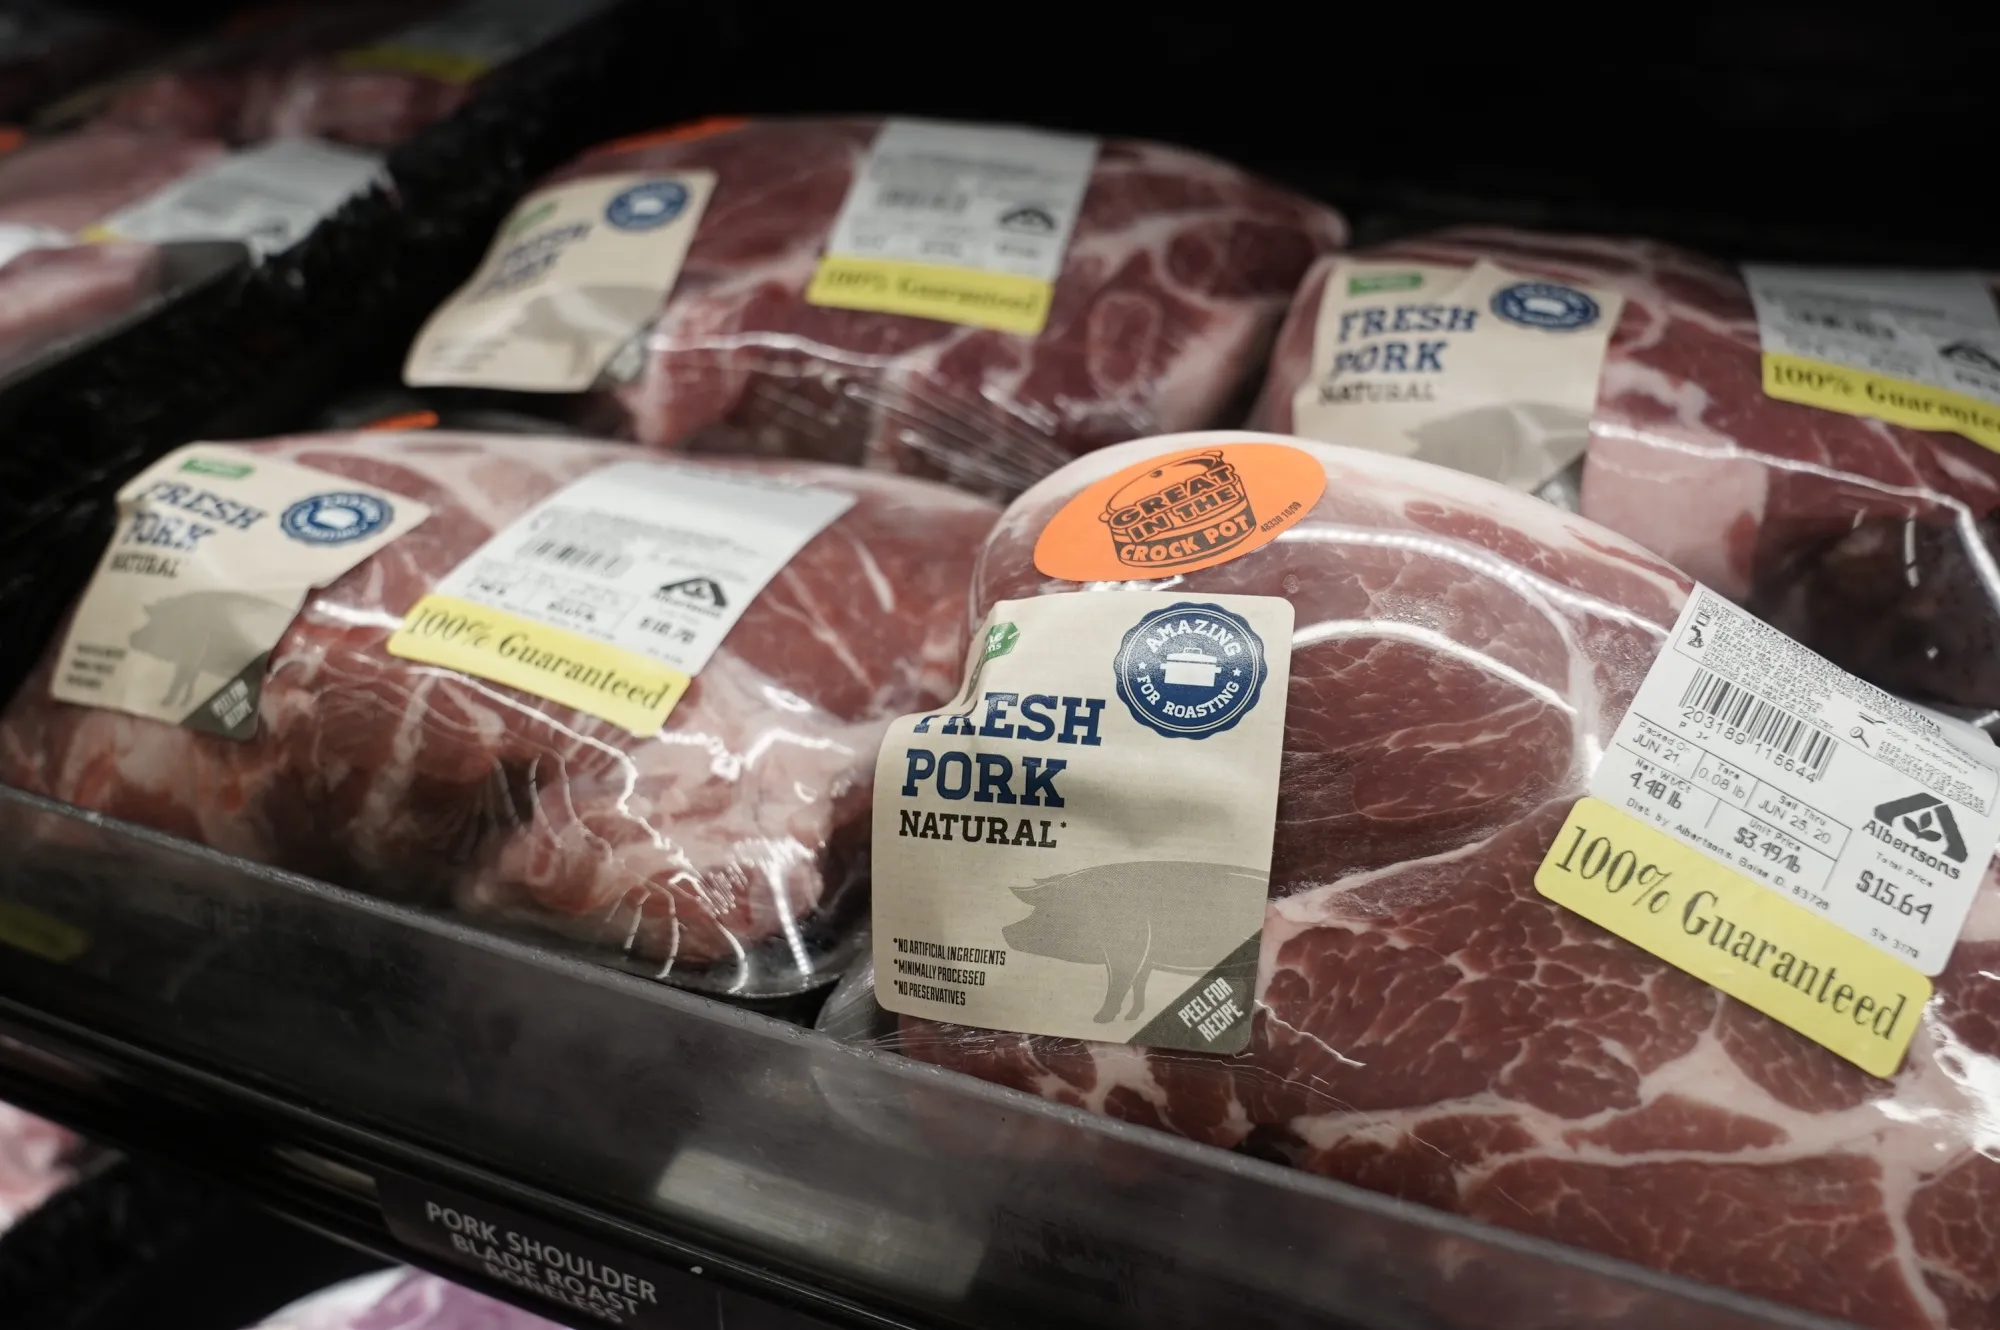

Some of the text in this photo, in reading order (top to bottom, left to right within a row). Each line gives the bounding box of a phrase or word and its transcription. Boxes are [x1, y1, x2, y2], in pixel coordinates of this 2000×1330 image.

[1338, 304, 1480, 342] FRESH
[1333, 341, 1449, 376] PORK
[1773, 365, 1854, 396] 100%
[1866, 380, 2000, 434] Guarante
[1110, 466, 1236, 528] GREAT
[1128, 485, 1240, 543] IN THE
[1120, 513, 1250, 564] CROCK POT
[406, 607, 494, 649] 100%
[498, 630, 671, 711] Guaranteed
[1145, 618, 1242, 657] AMAZING
[1137, 674, 1240, 719] FOR ROASTING
[1633, 734, 1660, 753] JUN
[1640, 721, 1674, 745] Packed
[1683, 706, 1819, 782] 203189 115644
[902, 748, 1067, 809] PORK
[1636, 759, 1655, 772] Net
[1699, 767, 1745, 799] 0.08 lb
[1719, 763, 1740, 780] Tare
[1631, 772, 1682, 809] 4.48 lb
[1779, 795, 1826, 826] Sell Thru
[1749, 819, 1801, 851] Unit Price
[1758, 800, 1785, 819] JUN
[1813, 828, 1831, 844] 20
[1655, 813, 1669, 826] by
[1739, 857, 1768, 878] Boise
[1793, 886, 1829, 910] 83728
[1734, 827, 1800, 873] $3.49/lb
[1863, 820, 1958, 878] Albertsons
[1877, 852, 1933, 887] Total Price
[1857, 870, 1932, 923] $15.64
[909, 940, 946, 960] ARTIFICIAL
[947, 946, 1006, 966] INGREDIENTS
[1554, 826, 1907, 1041] 100% Guaranteed
[899, 959, 986, 986] MINIMALLY PROCESSED
[909, 983, 966, 1006] PRESERVATIVES
[1178, 978, 1233, 1027] PEEL FOR
[1198, 999, 1243, 1041] RECIPE
[425, 1200, 658, 1304] PORK SHOULDER
[452, 1232, 639, 1316] BLADE ROAST
[485, 1261, 623, 1325] BONELESS
